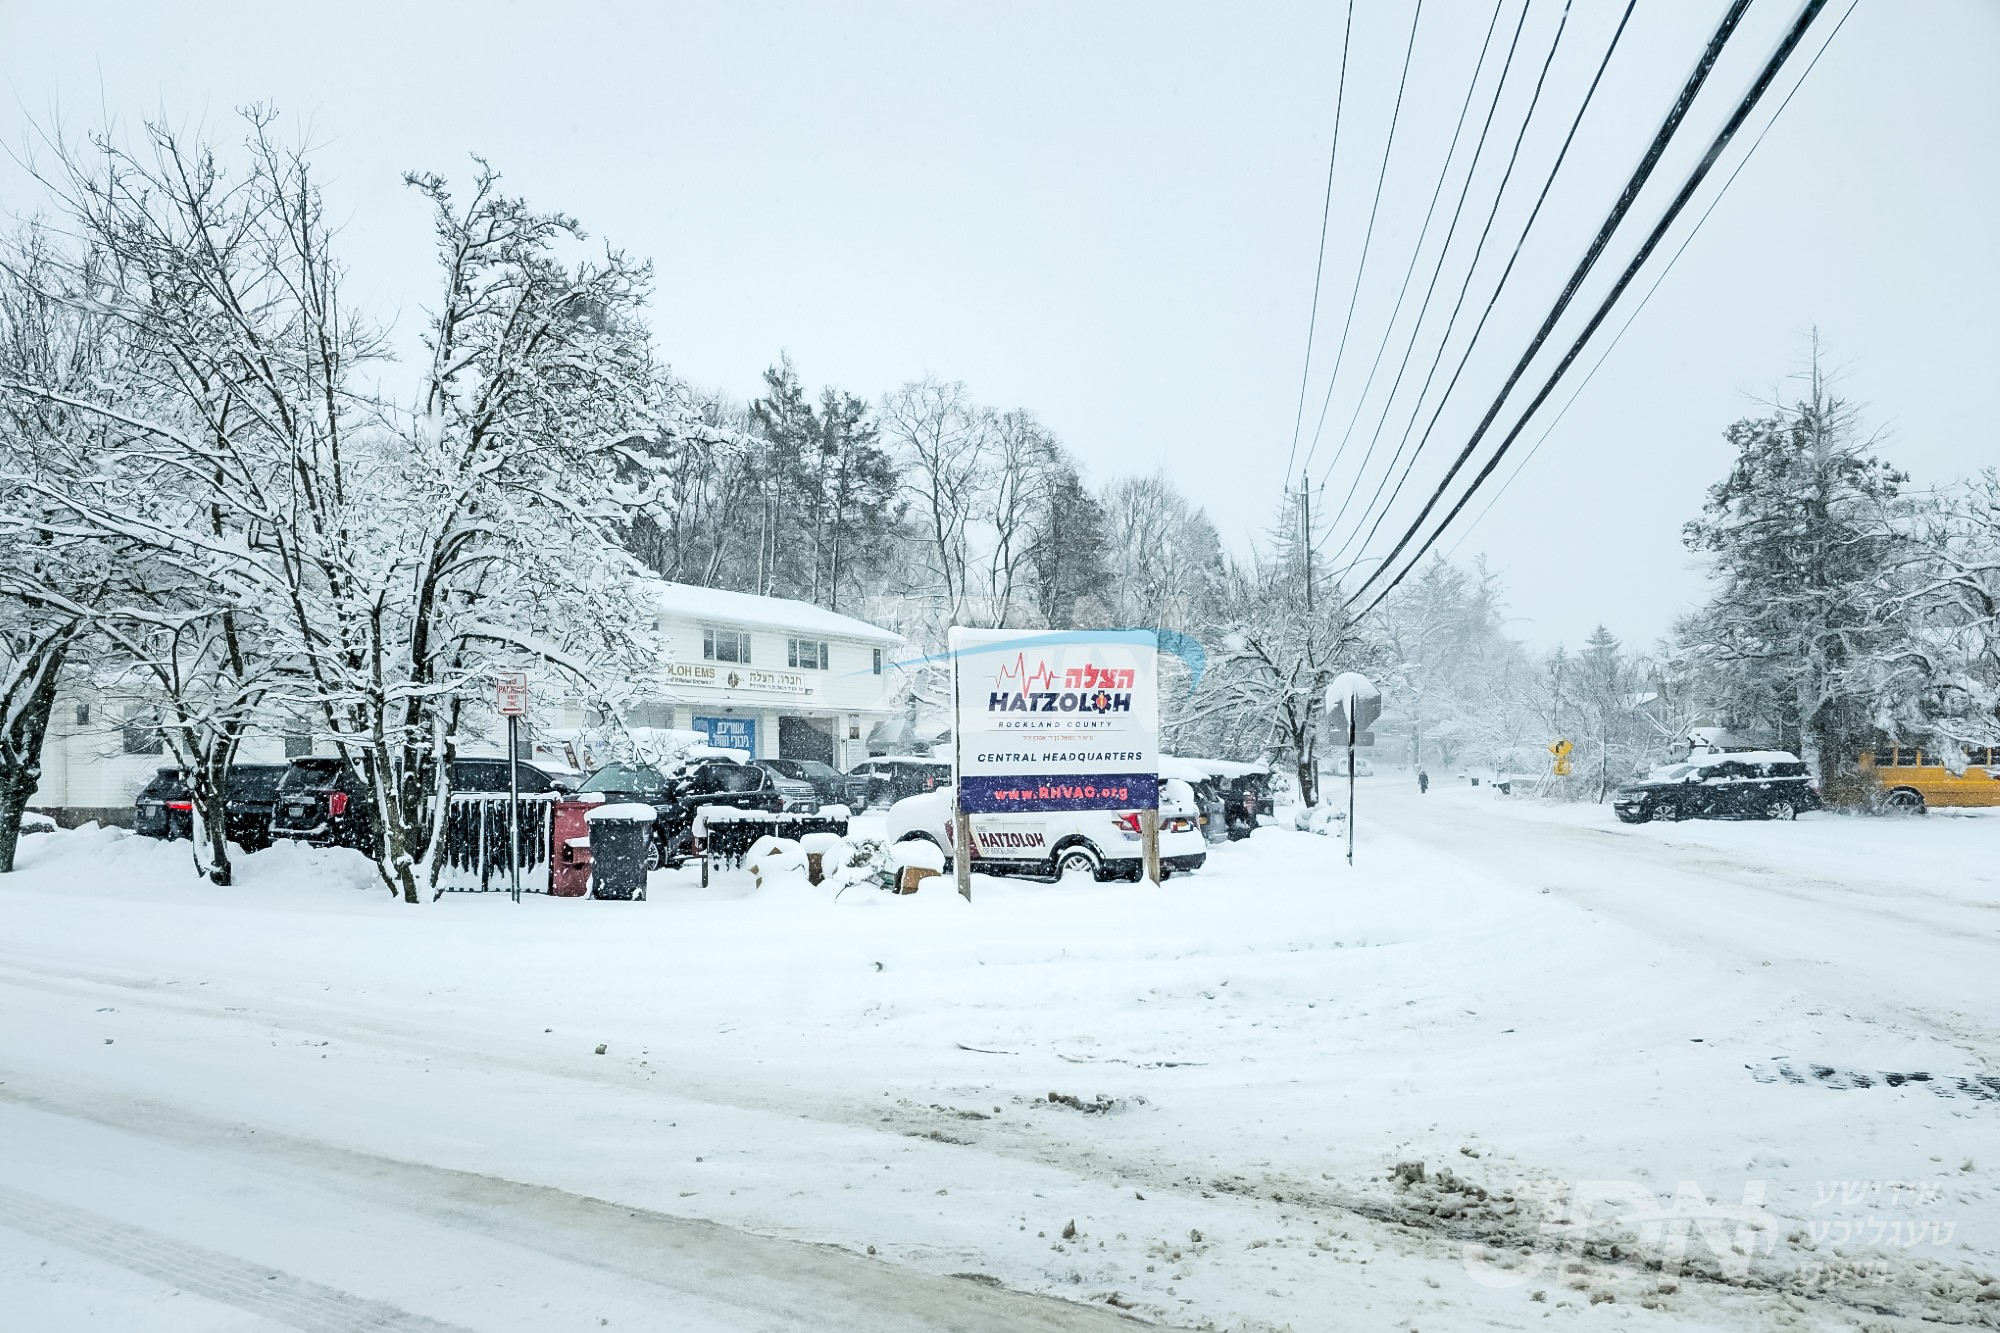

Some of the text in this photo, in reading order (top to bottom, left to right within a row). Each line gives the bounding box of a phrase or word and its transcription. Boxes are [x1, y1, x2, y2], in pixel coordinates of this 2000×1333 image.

[694, 667, 716, 678] EMS
[1064, 663, 1135, 689] הצלה
[988, 690, 1132, 714] HATZOLOH
[978, 752, 1142, 762] CENTRAL HEADQUARTERS
[978, 832, 1046, 848] HATZOLOH
